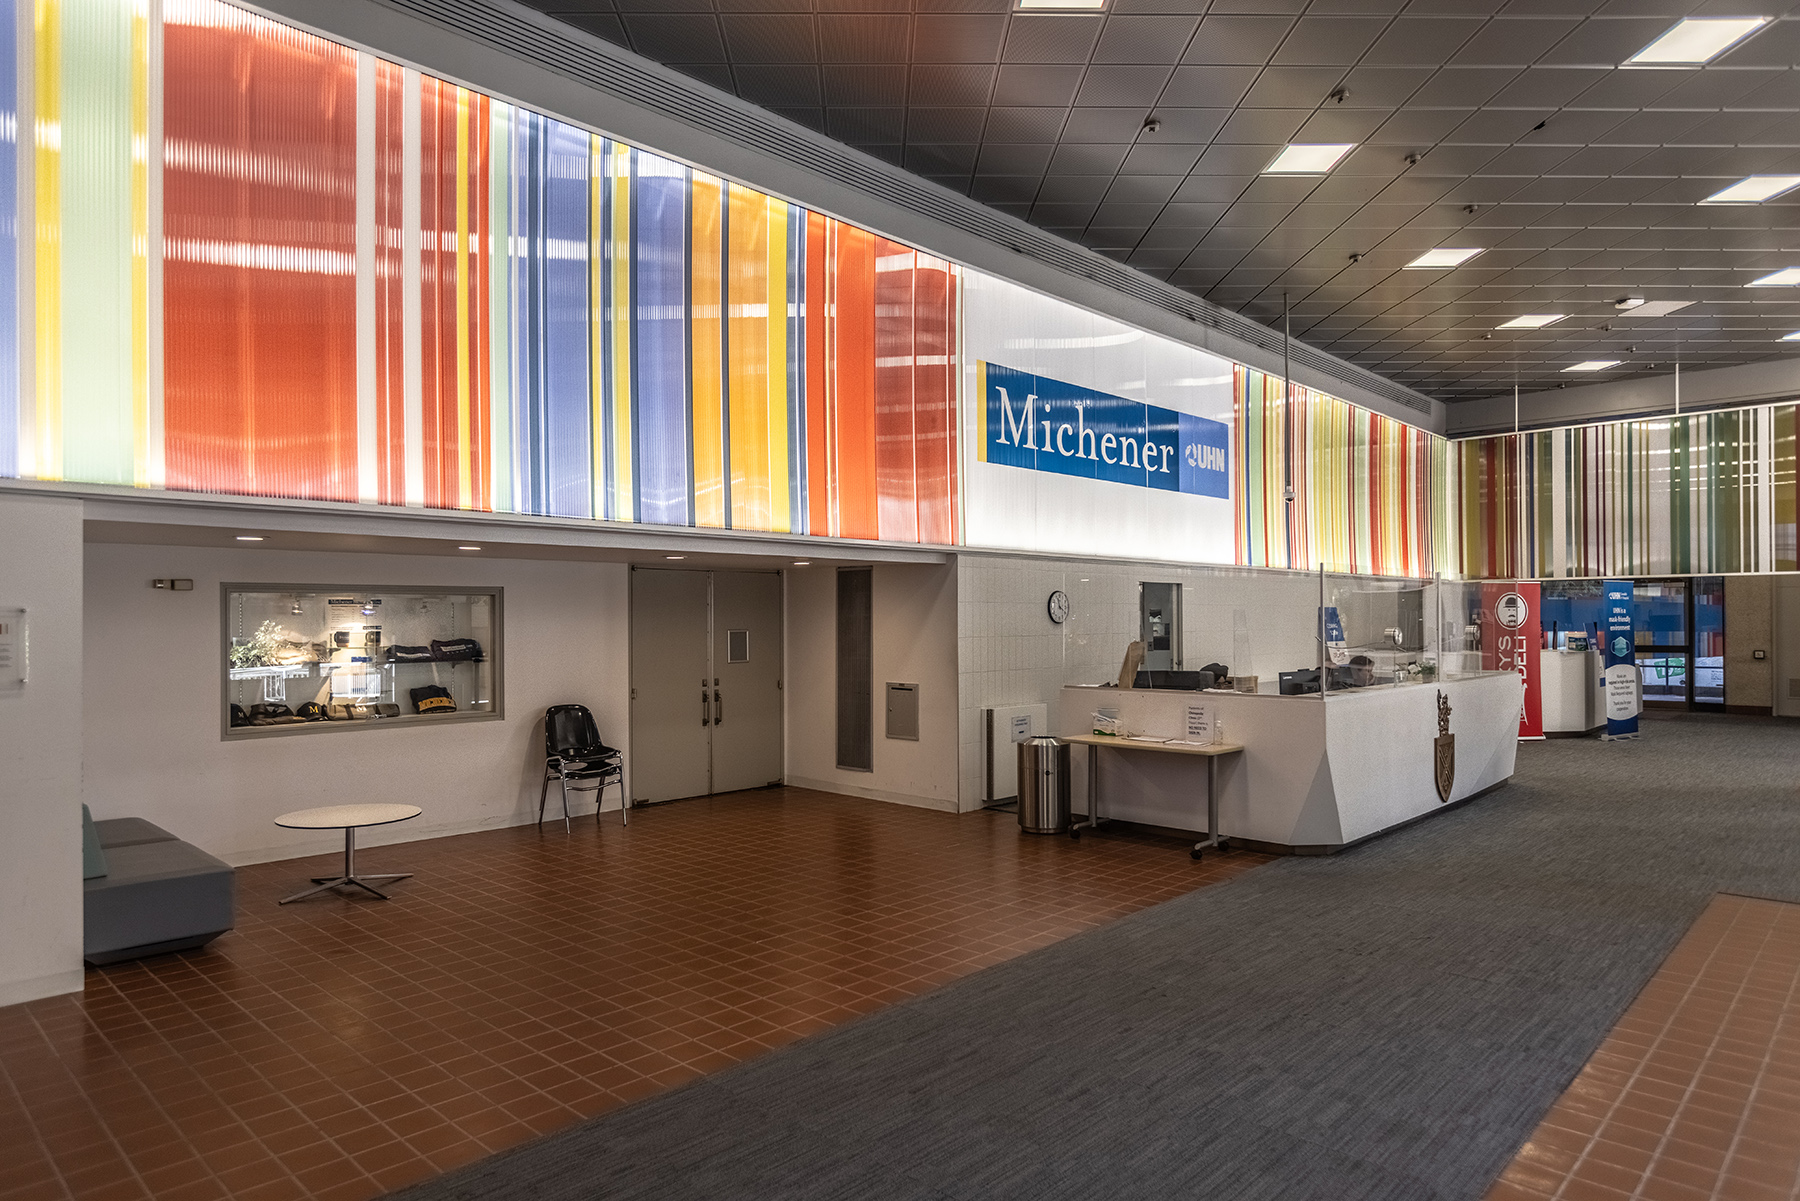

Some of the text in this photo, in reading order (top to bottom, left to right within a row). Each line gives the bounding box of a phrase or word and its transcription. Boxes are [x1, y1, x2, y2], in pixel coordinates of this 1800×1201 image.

[995, 385, 1174, 474] Michener
[1197, 443, 1225, 473] UHN
[1513, 635, 1527, 680] DELI
[309, 705, 319, 714] M
